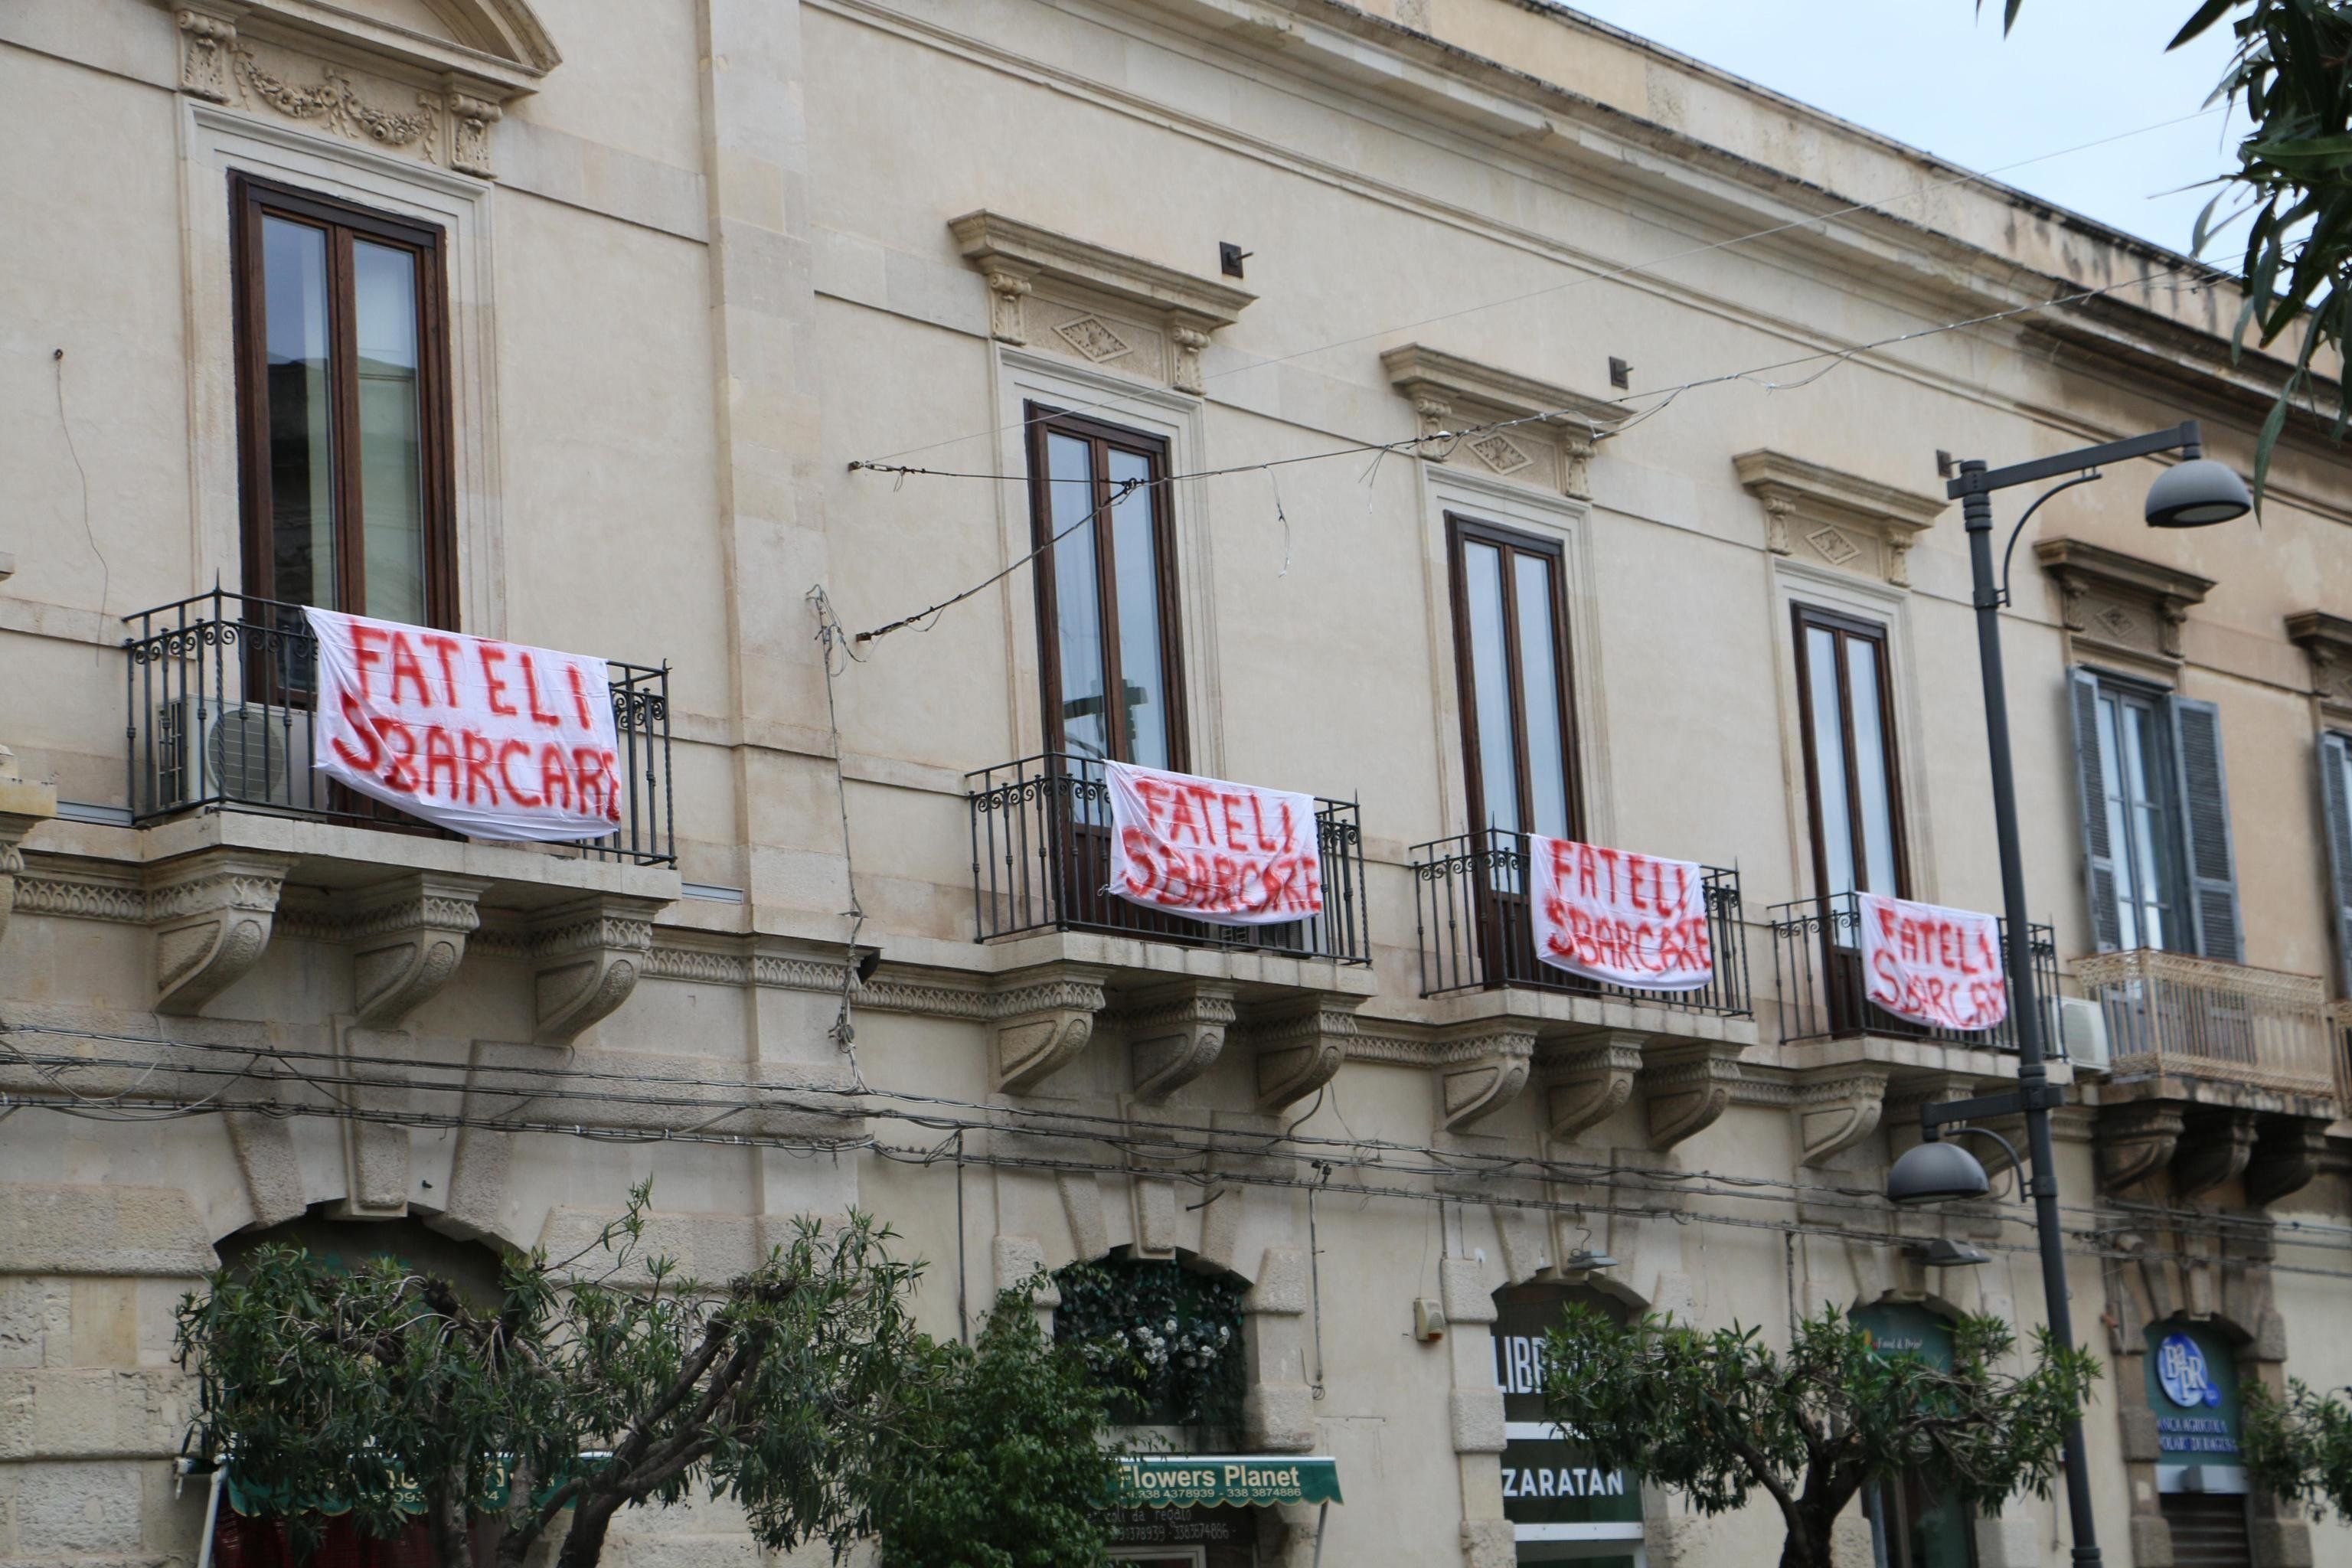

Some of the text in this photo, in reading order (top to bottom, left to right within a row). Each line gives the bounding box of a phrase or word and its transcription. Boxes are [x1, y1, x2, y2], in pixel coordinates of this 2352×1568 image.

[350, 619, 591, 731] FATELI
[1134, 778, 1294, 854] FATELI
[1550, 839, 1687, 918] FATELI
[1119, 1465, 1302, 1488] Flowers Planet
[1227, 1488, 1249, 1498] 338
[1251, 1488, 1302, 1498] 3874886
[1501, 1468, 1624, 1498] ZARATAN
